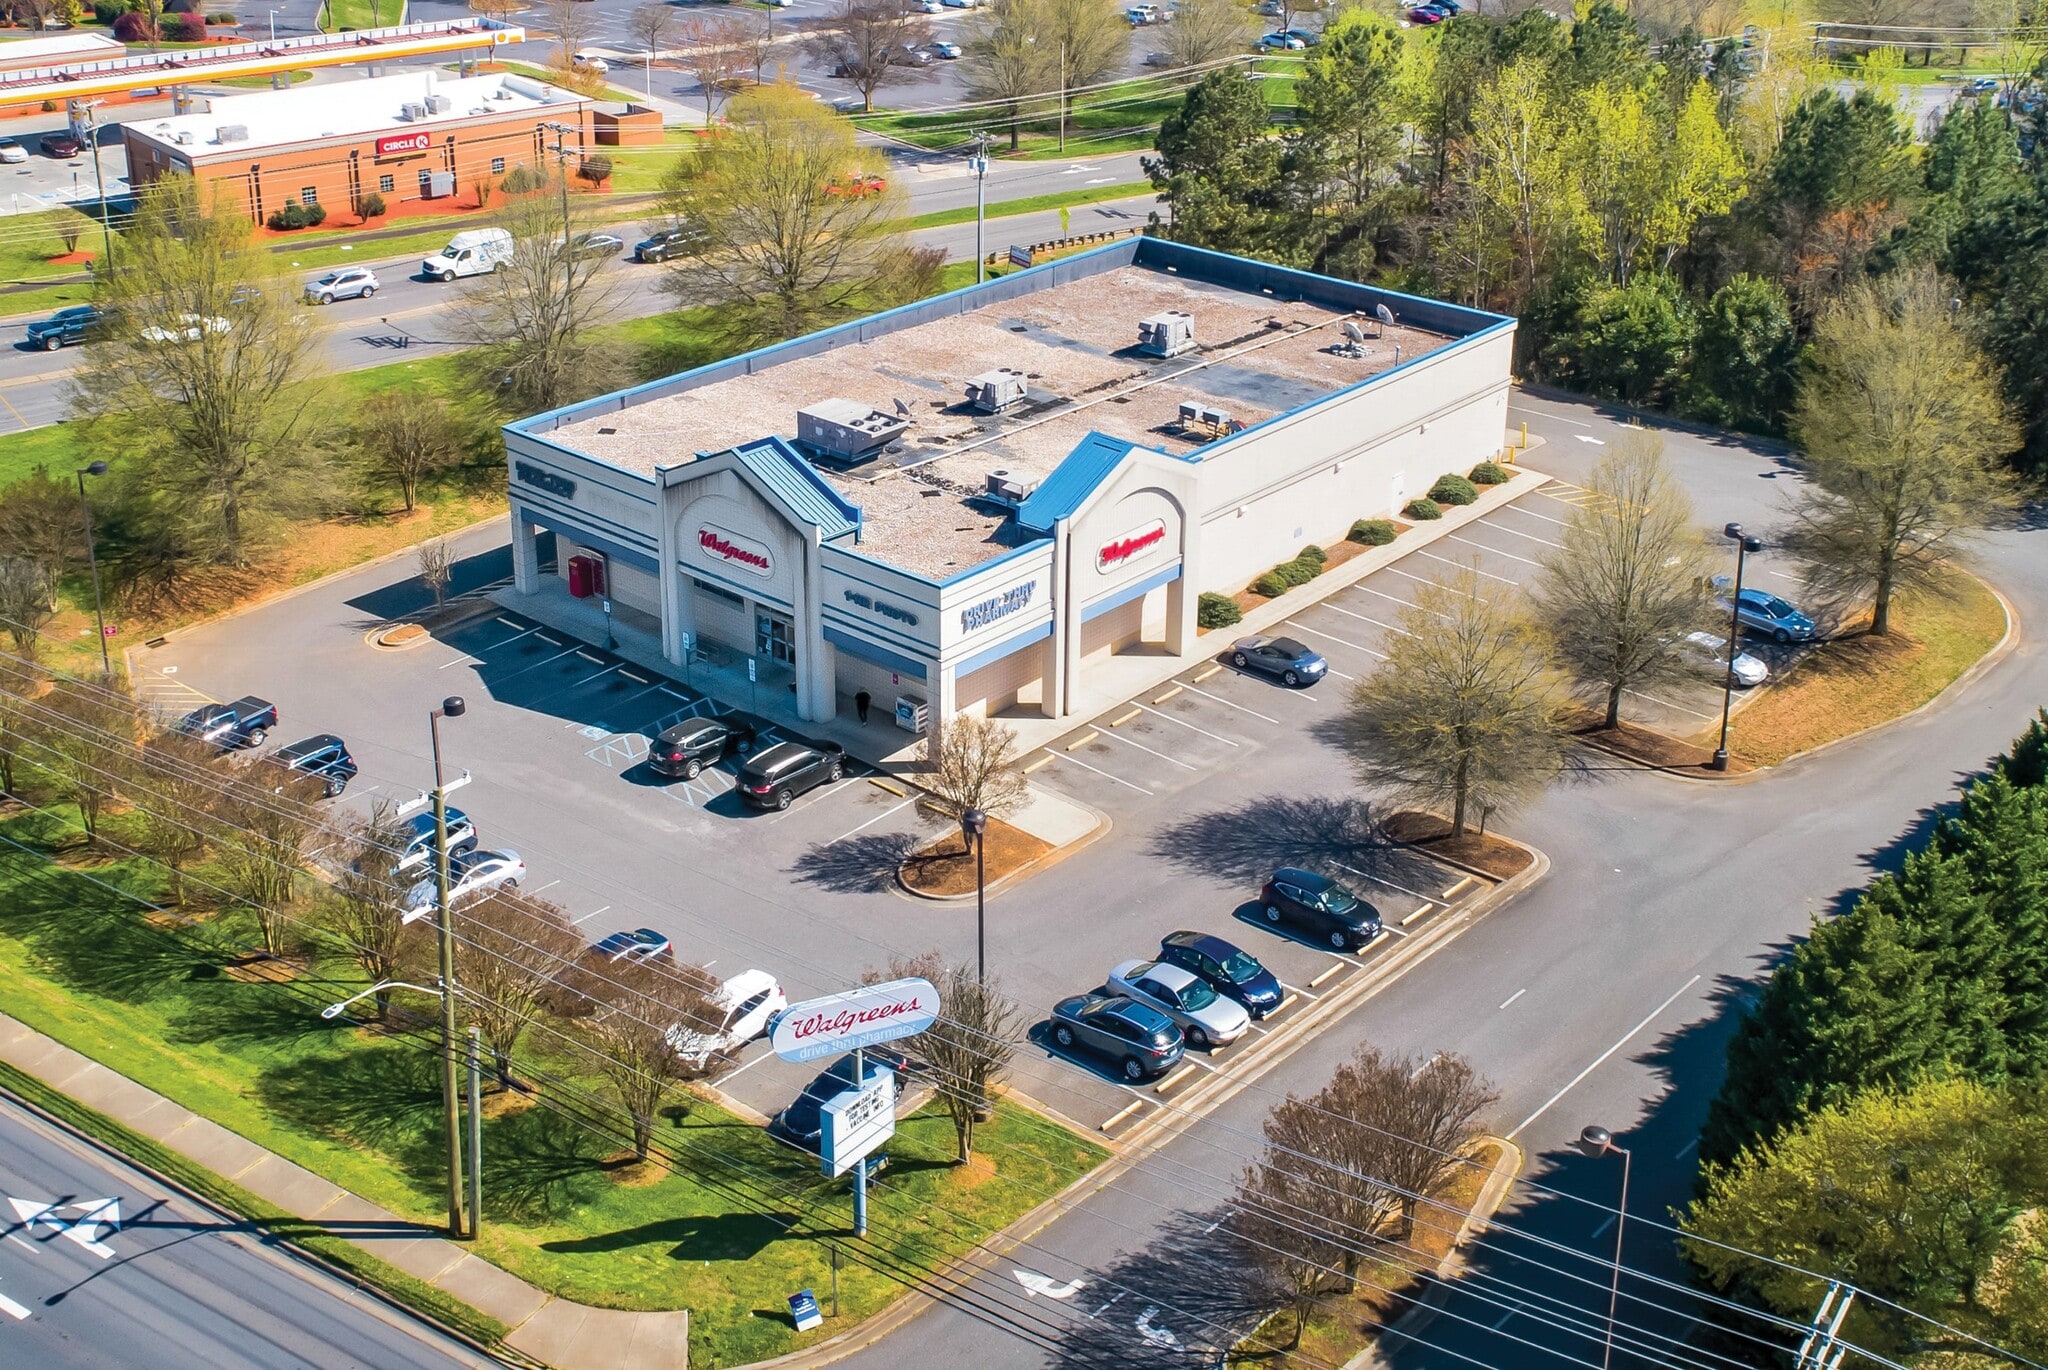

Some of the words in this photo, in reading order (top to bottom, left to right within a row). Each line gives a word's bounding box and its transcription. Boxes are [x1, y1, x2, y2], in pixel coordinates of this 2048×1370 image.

[383, 139, 415, 152] CIRCLE
[417, 136, 428, 148] K
[699, 529, 770, 569] Walgreens
[792, 997, 922, 1039] Walgreens
[799, 1044, 829, 1060] drive
[832, 1038, 856, 1051] thru
[858, 1024, 916, 1046] pharmacy
